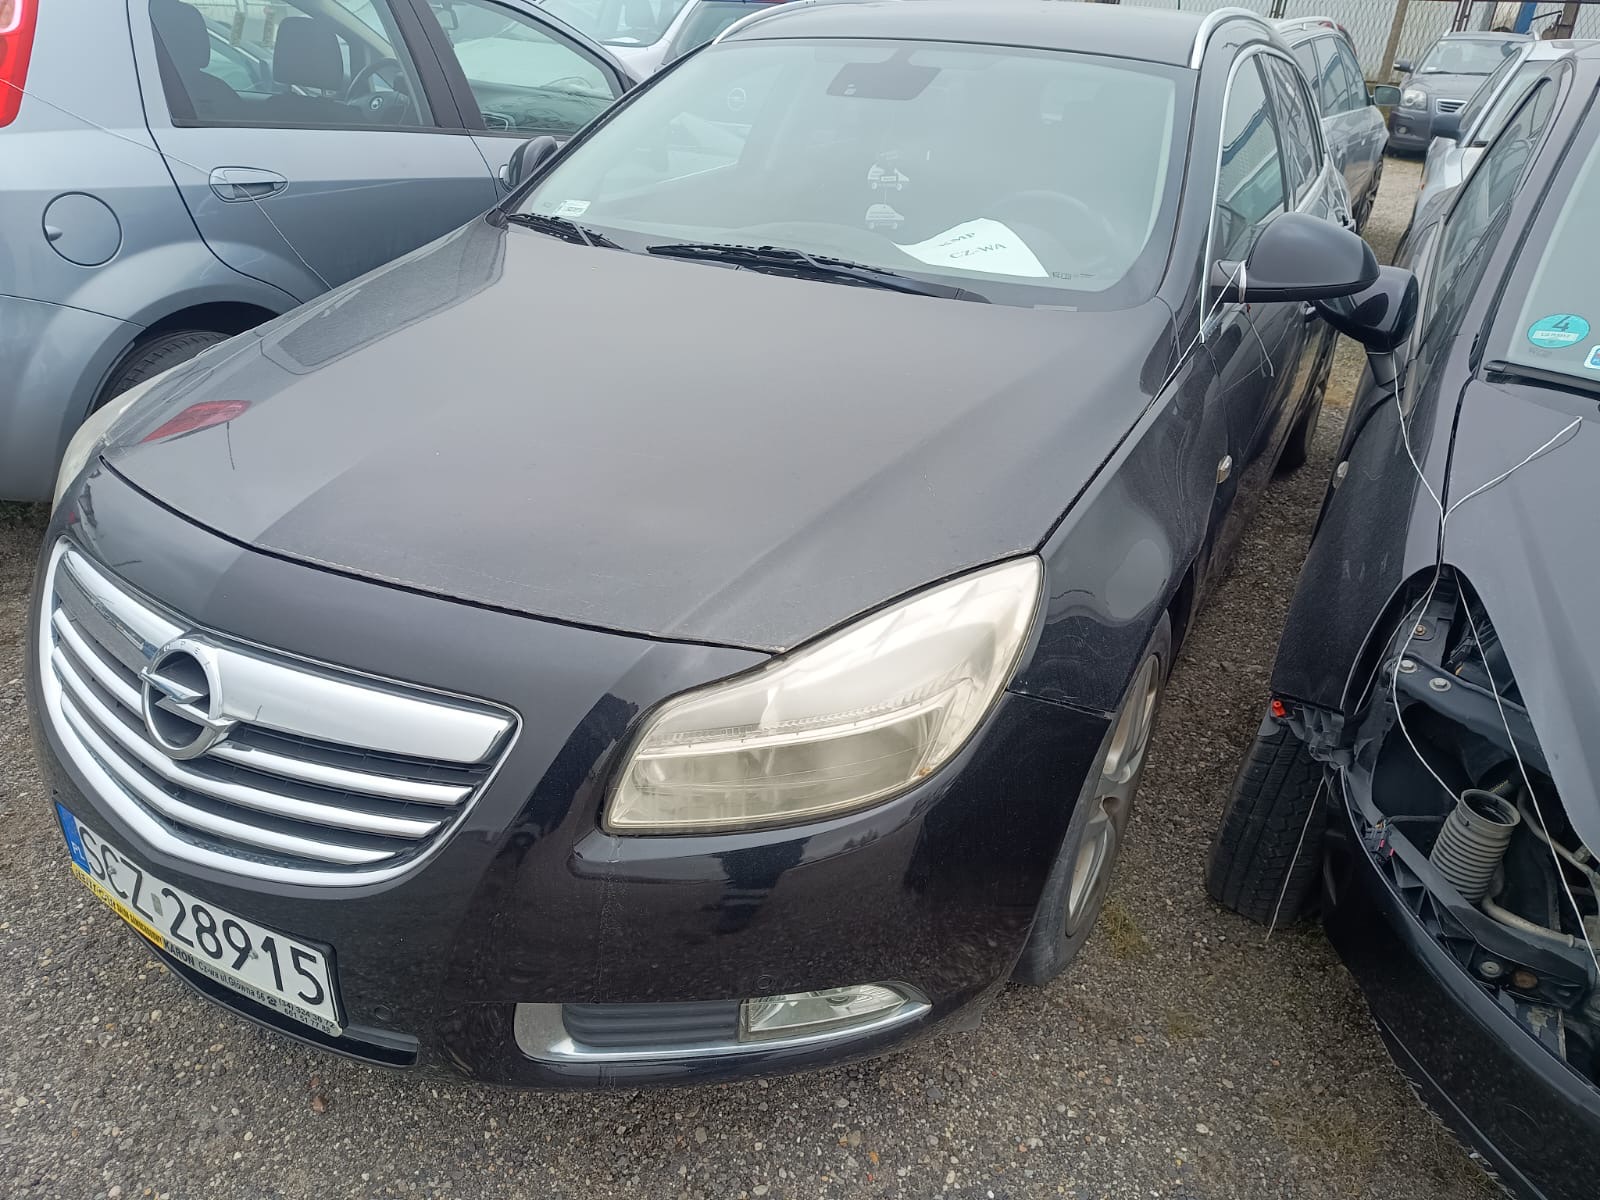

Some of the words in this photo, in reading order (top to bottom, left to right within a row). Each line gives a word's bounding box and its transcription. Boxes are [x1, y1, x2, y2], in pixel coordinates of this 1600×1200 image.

[949, 243, 1007, 259] CZ-WA
[1552, 315, 1571, 332] 4
[71, 841, 86, 861] PL
[161, 887, 326, 1006] 28915
